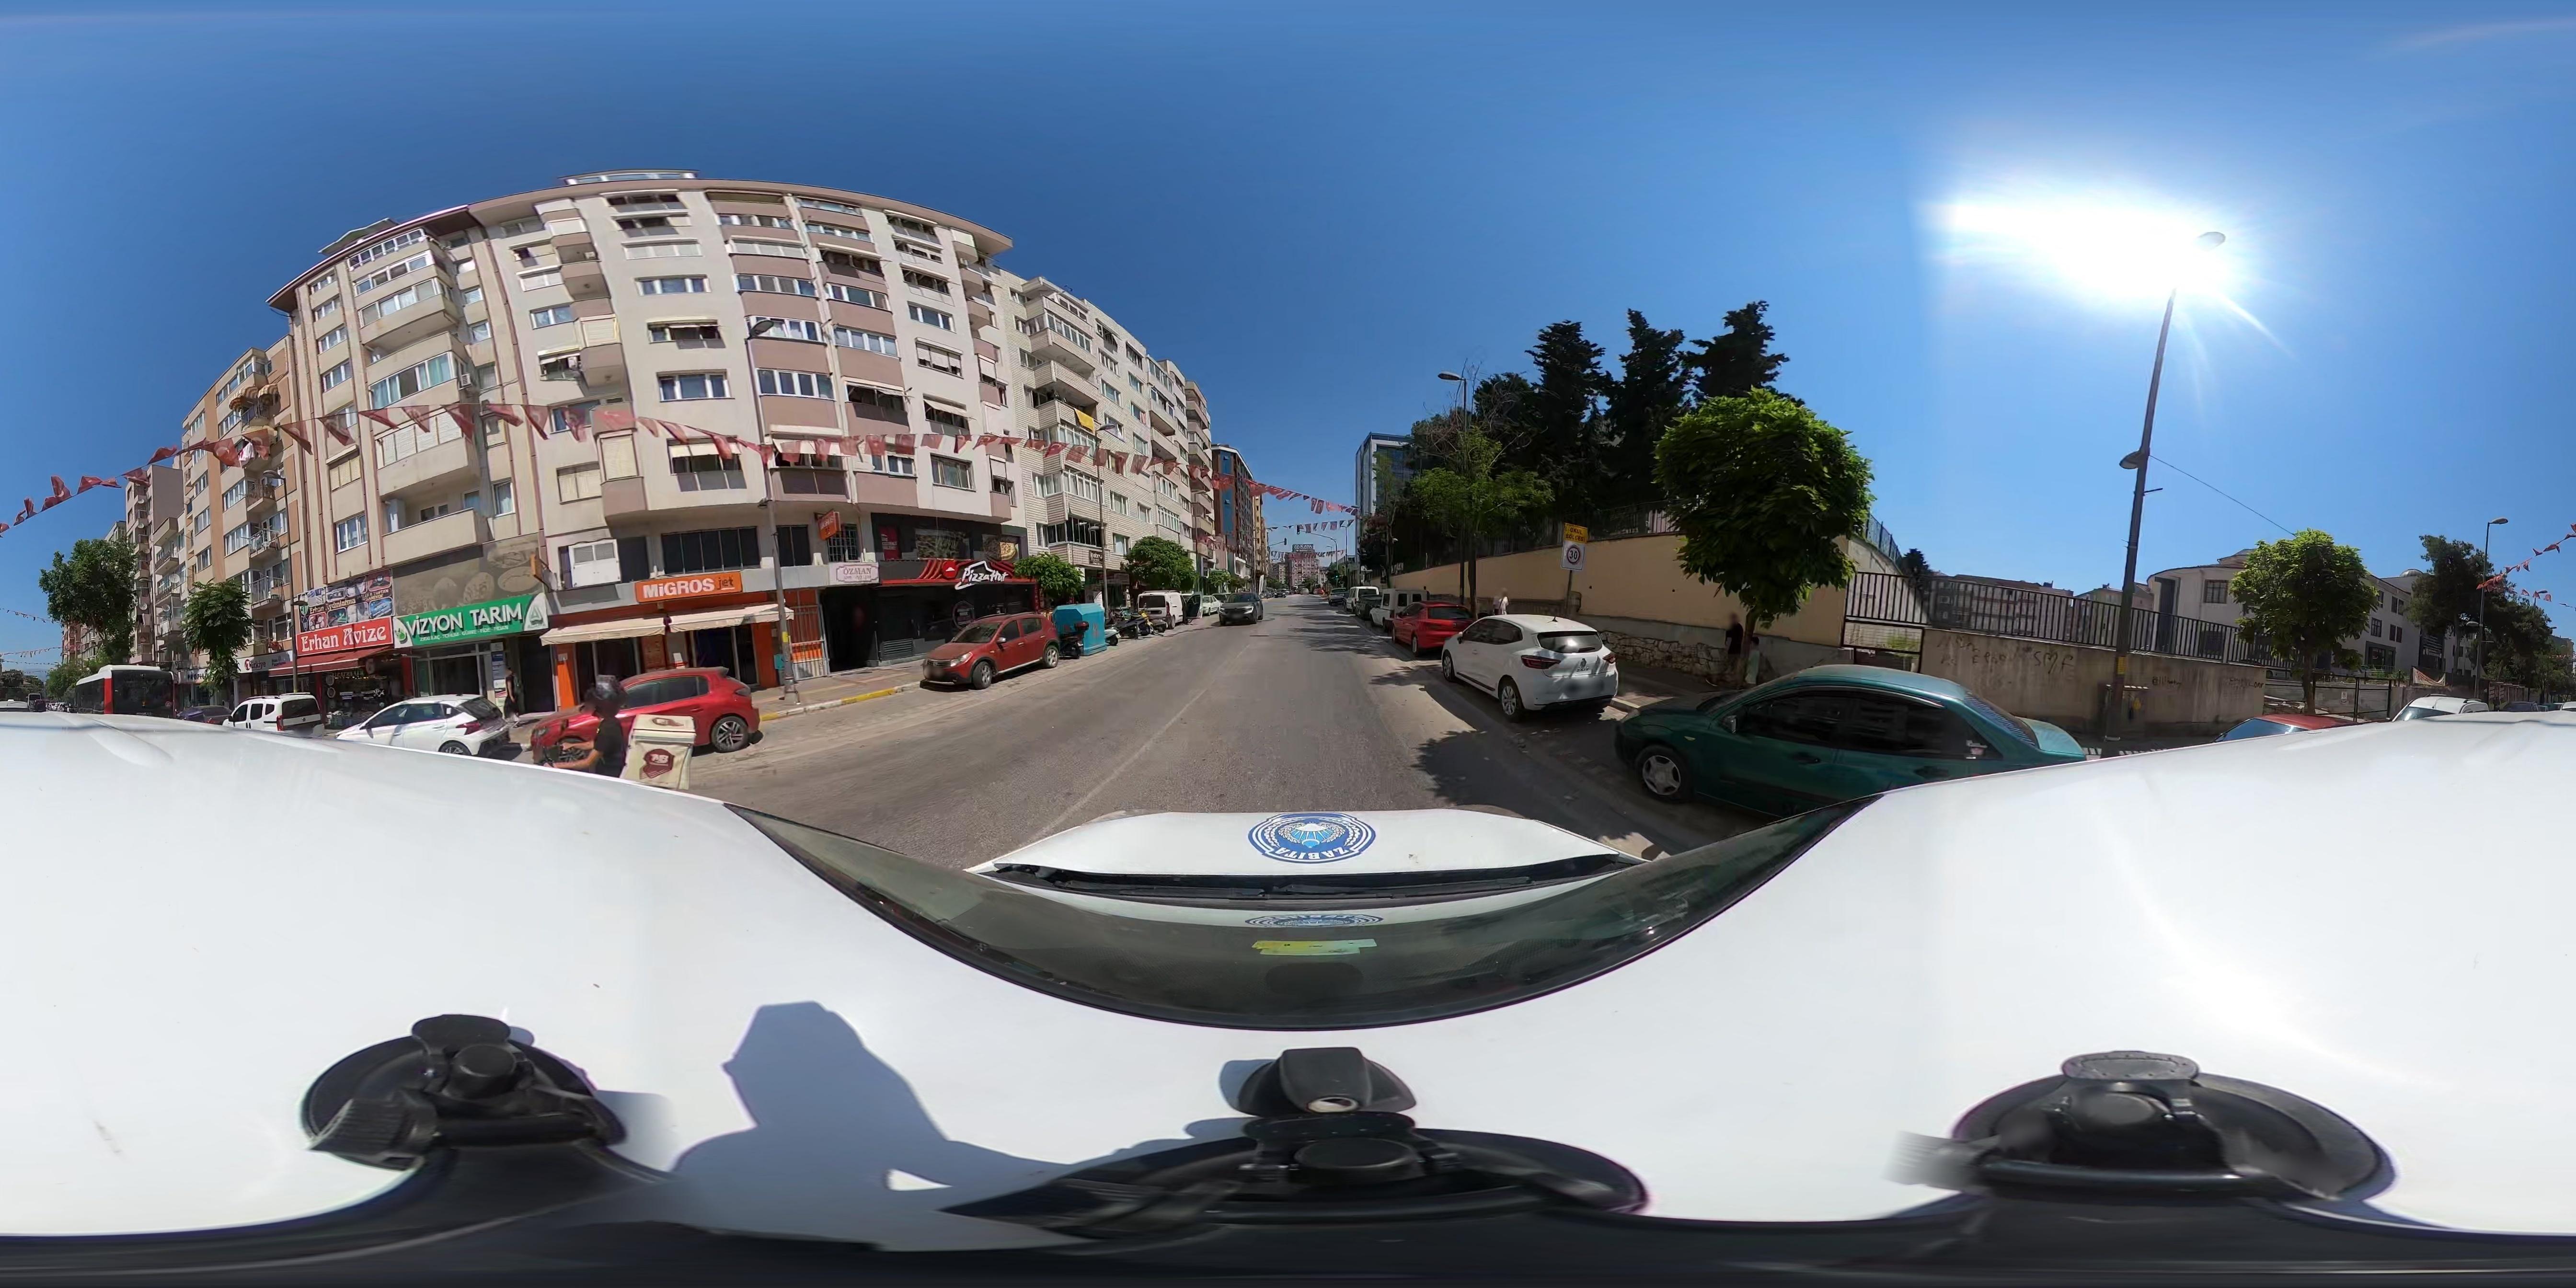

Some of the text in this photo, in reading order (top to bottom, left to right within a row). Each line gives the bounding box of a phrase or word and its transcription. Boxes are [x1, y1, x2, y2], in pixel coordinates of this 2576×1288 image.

[1569, 550, 1578, 560] 30
[962, 567, 1009, 582] Pizza Hut
[717, 576, 734, 590] jet
[406, 602, 522, 636] VİZYON TARIM
[301, 626, 387, 652] Erhan Avize
[1275, 846, 1349, 860] ZABITA
